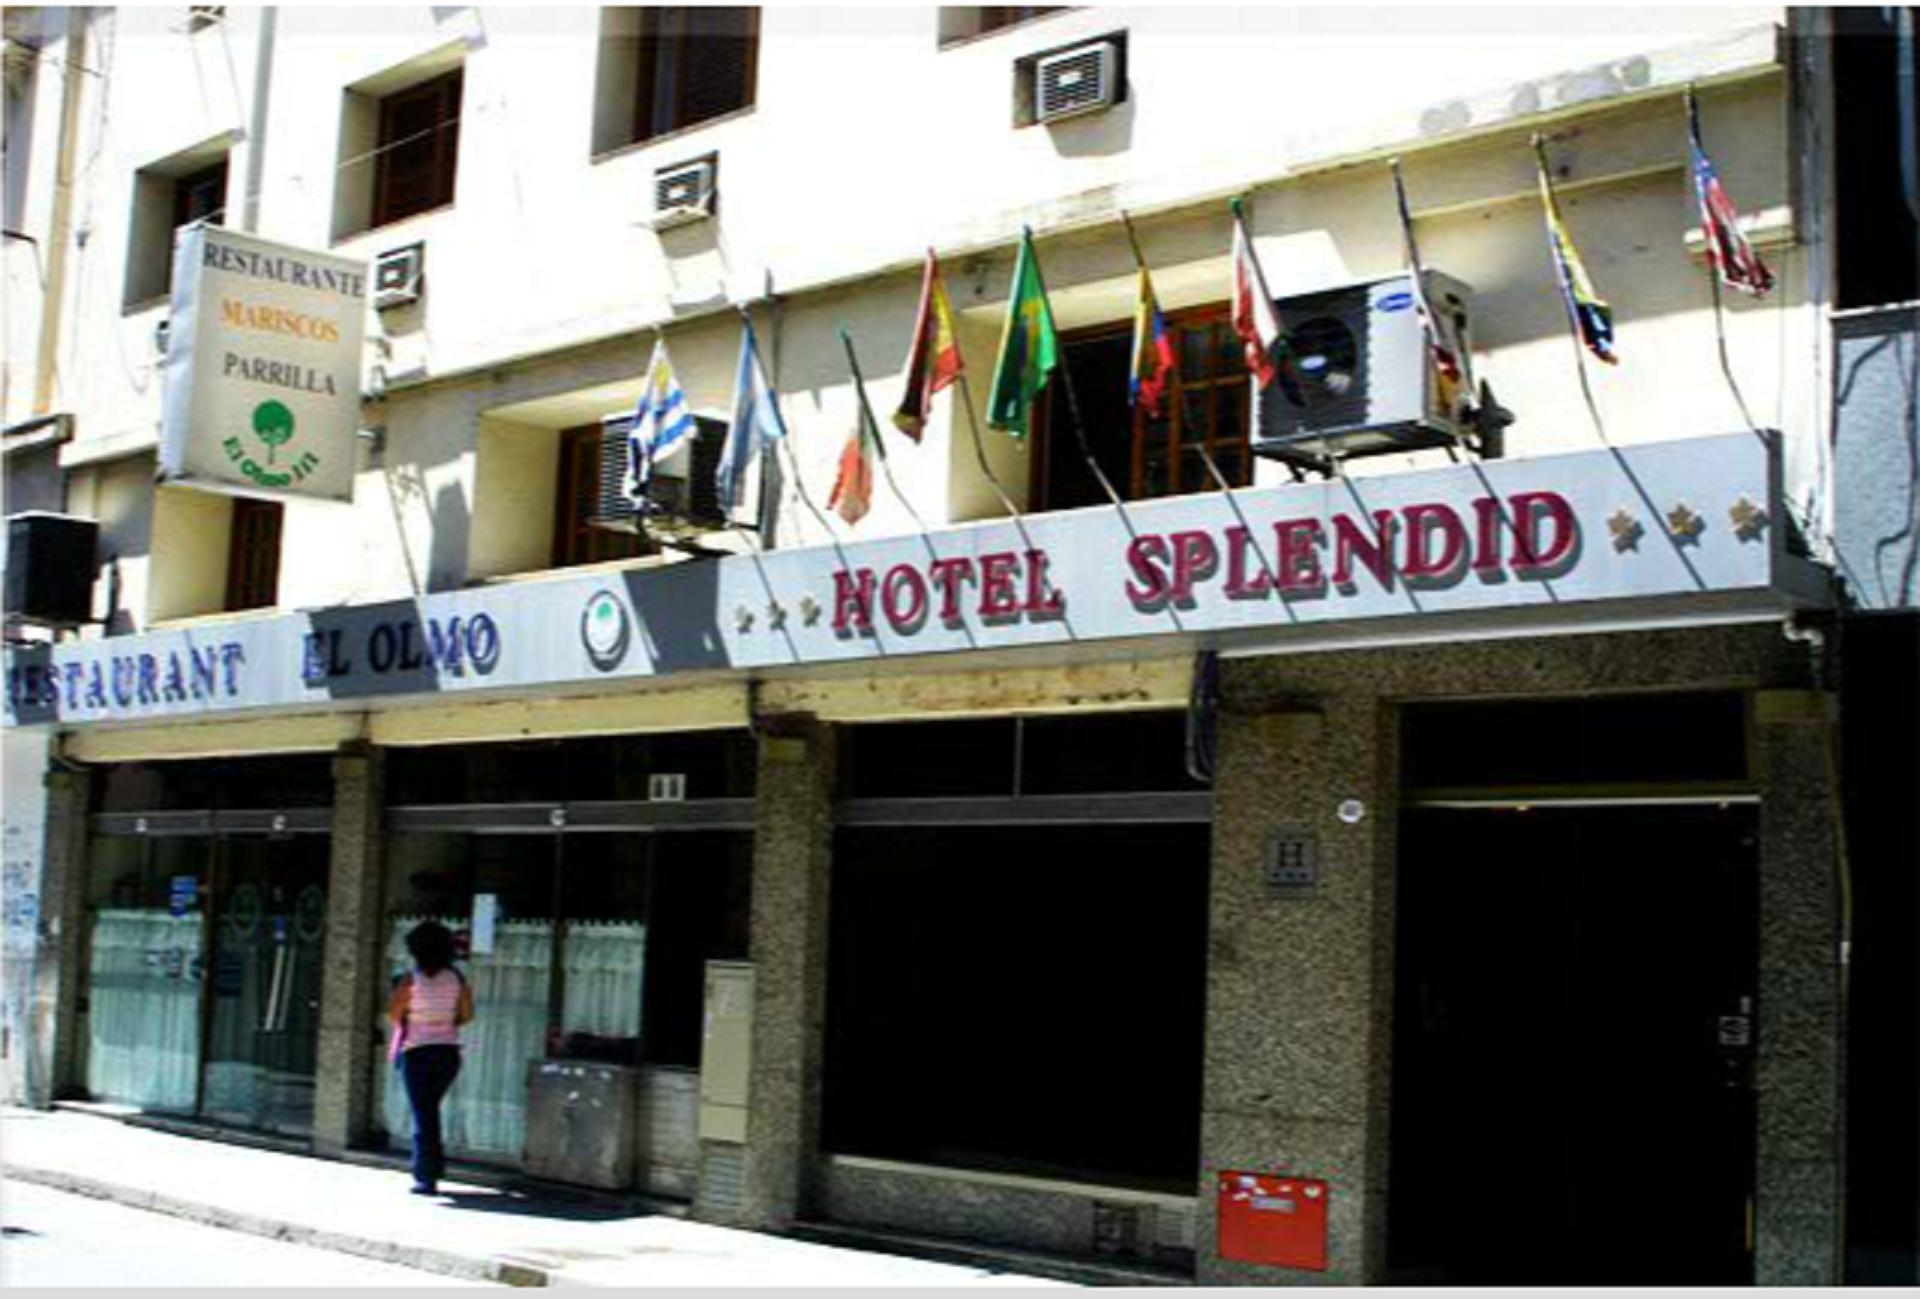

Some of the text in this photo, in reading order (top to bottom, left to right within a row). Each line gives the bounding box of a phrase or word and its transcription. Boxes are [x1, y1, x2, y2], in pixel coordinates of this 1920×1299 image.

[203, 241, 365, 297] RESTAURANTE
[222, 299, 339, 342] MARISCOS
[224, 352, 335, 395] PARRILLA
[832, 491, 1577, 630] HOTEL SPLENDID
[301, 630, 349, 678] EL
[369, 613, 499, 675] OLMO
[1279, 843, 1303, 867] H
